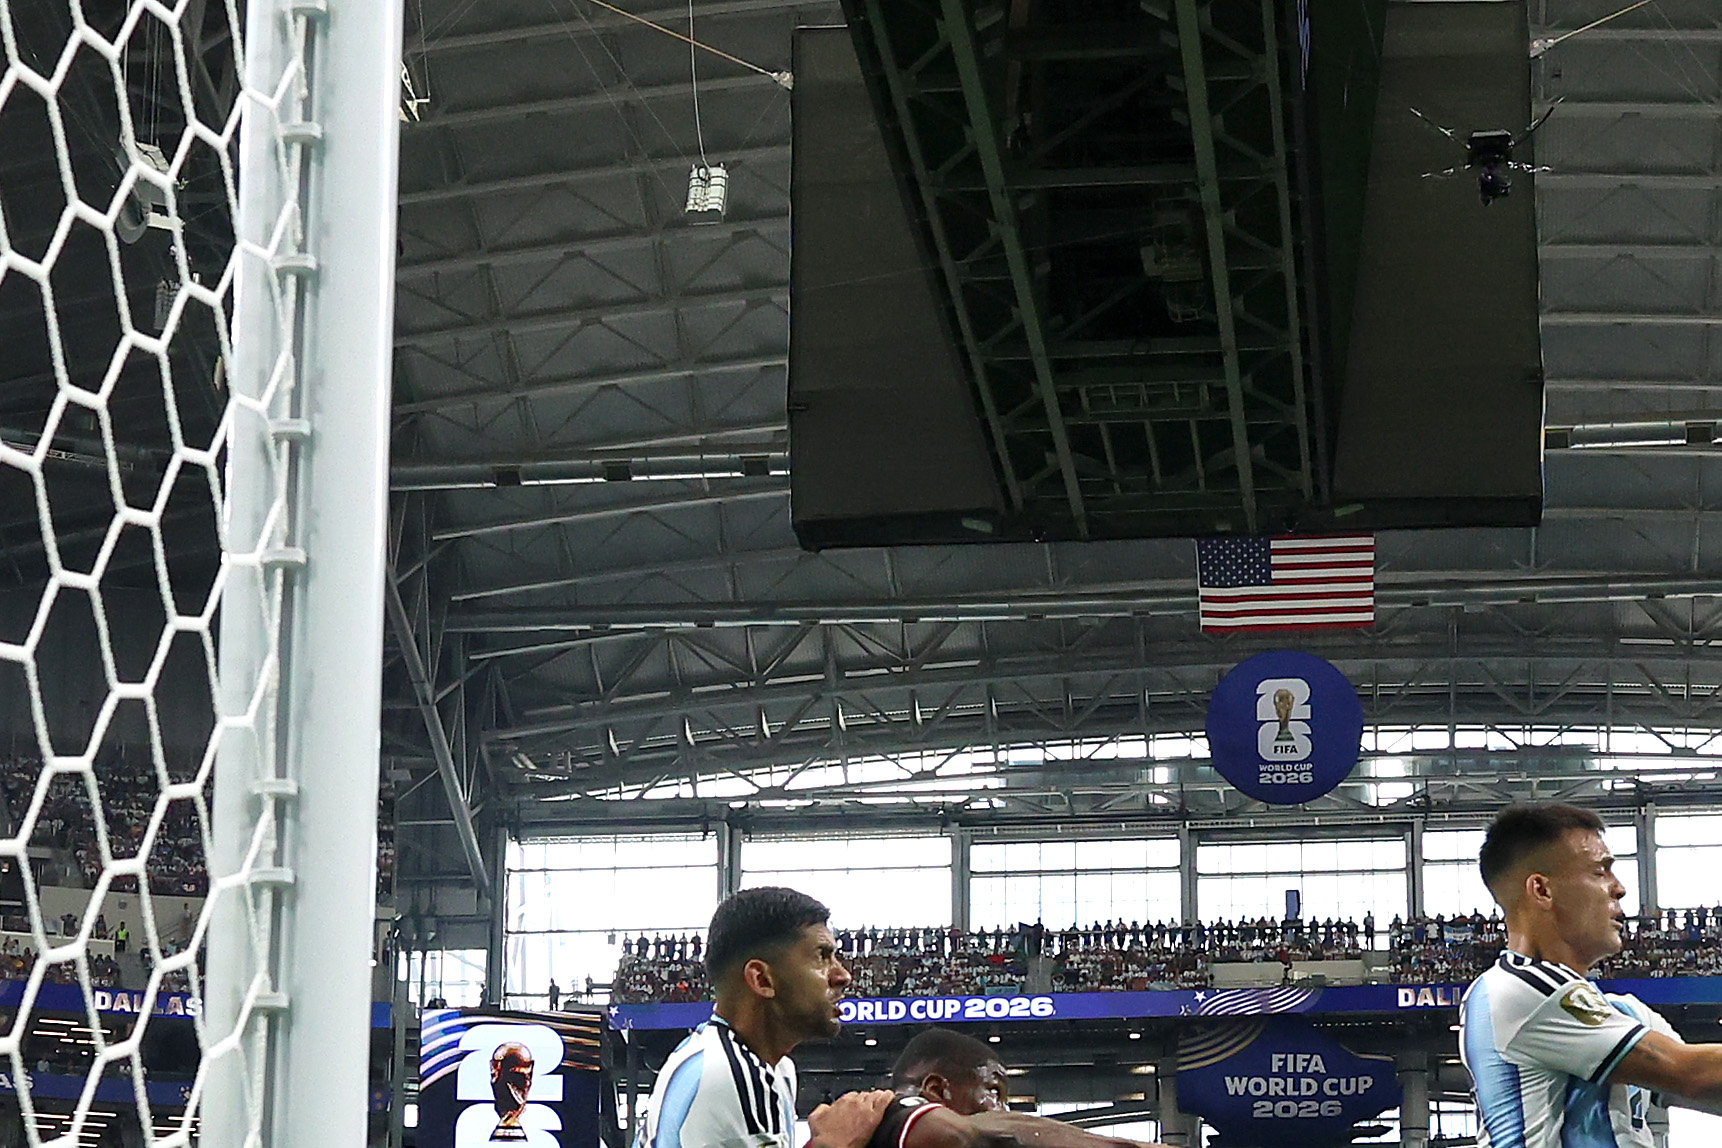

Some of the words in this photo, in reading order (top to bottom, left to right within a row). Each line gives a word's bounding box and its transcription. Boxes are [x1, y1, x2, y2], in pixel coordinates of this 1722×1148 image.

[1274, 745, 1298, 754] FIFA
[1259, 764, 1292, 772] WORLD
[1294, 764, 1313, 772] CUP
[1259, 772, 1313, 784] 2026
[910, 999, 961, 1020] CUP
[964, 996, 1054, 1018] 2026
[1271, 1053, 1327, 1073] FIFA
[1225, 1076, 1318, 1096] WORLD
[1322, 1076, 1373, 1095] CUP
[1253, 1100, 1342, 1118] 2026
